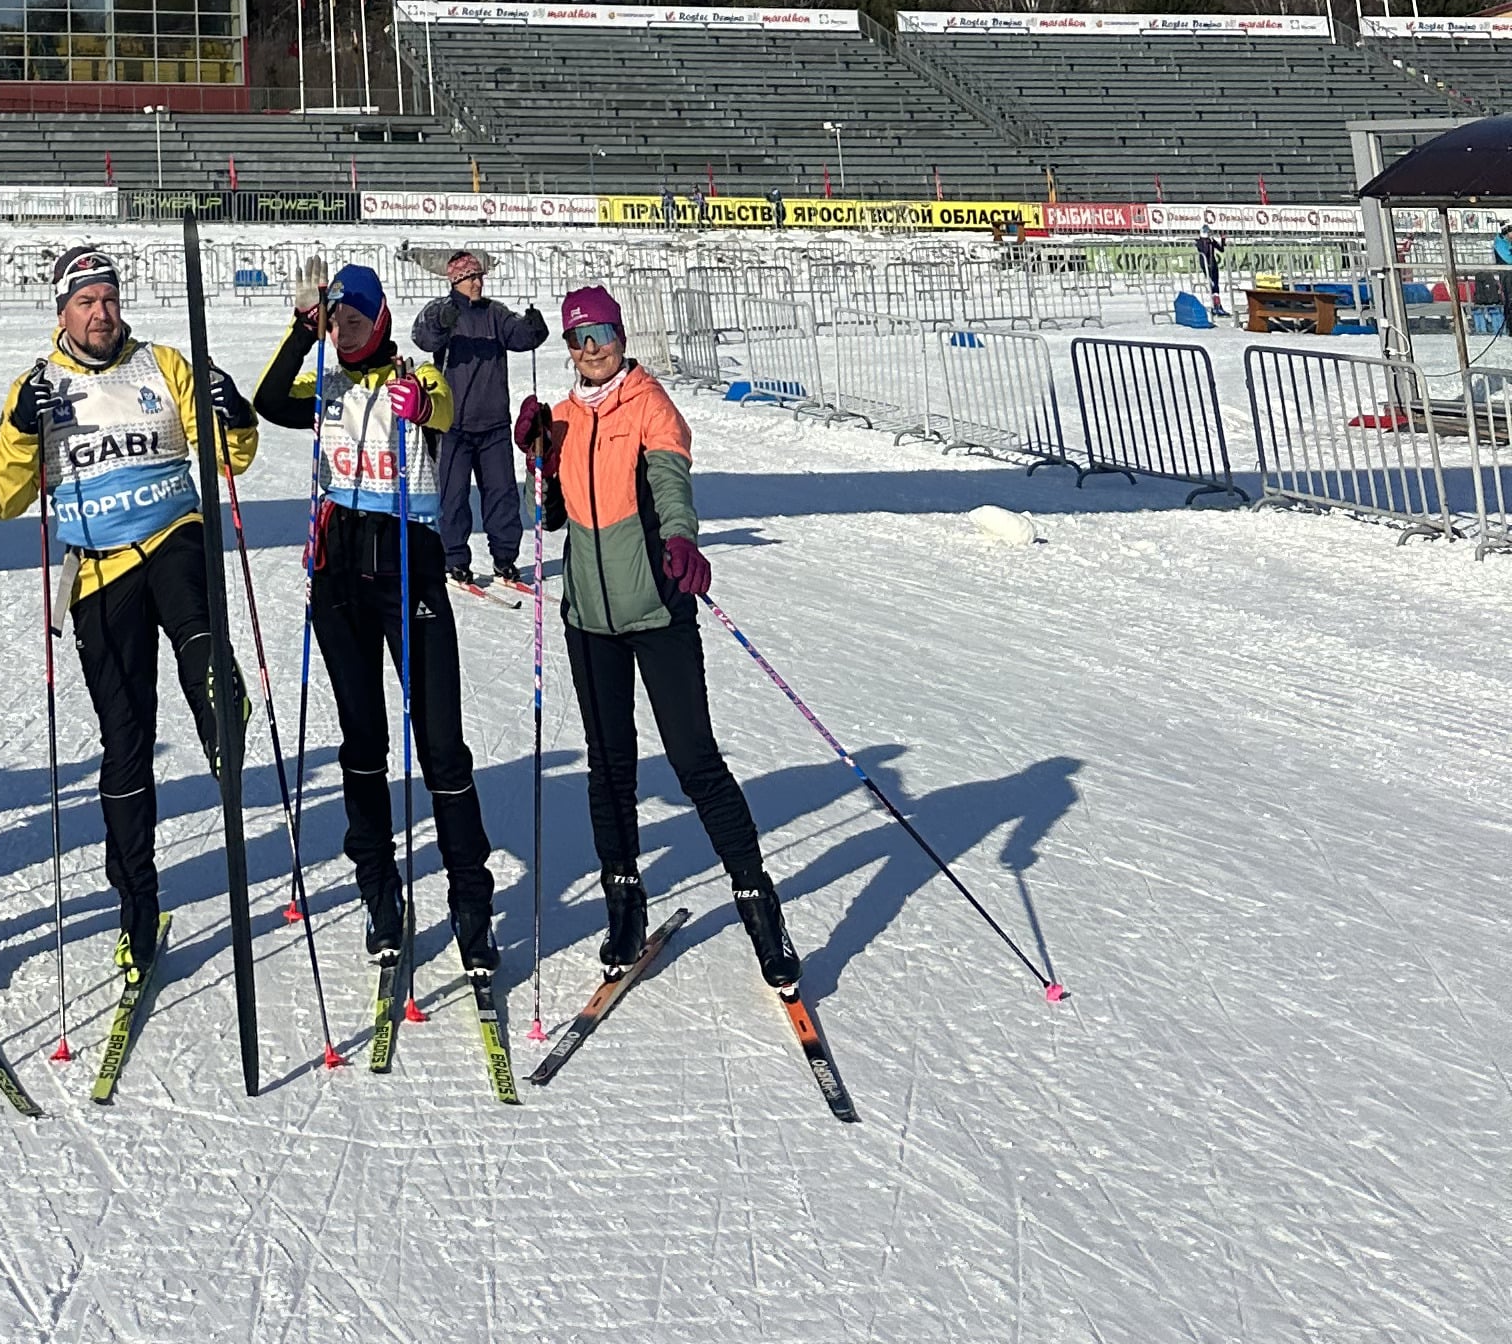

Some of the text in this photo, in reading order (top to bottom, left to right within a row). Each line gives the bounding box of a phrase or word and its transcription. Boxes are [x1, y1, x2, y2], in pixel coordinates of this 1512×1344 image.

[940, 208, 1023, 225] ОБЛАСТИ
[1047, 208, 1126, 226] РЫБИНСК
[69, 432, 160, 468] GABI
[99, 1034, 126, 1080] BRADOS
[371, 1026, 389, 1063] BRADOS
[490, 1053, 514, 1095] BRADOS
